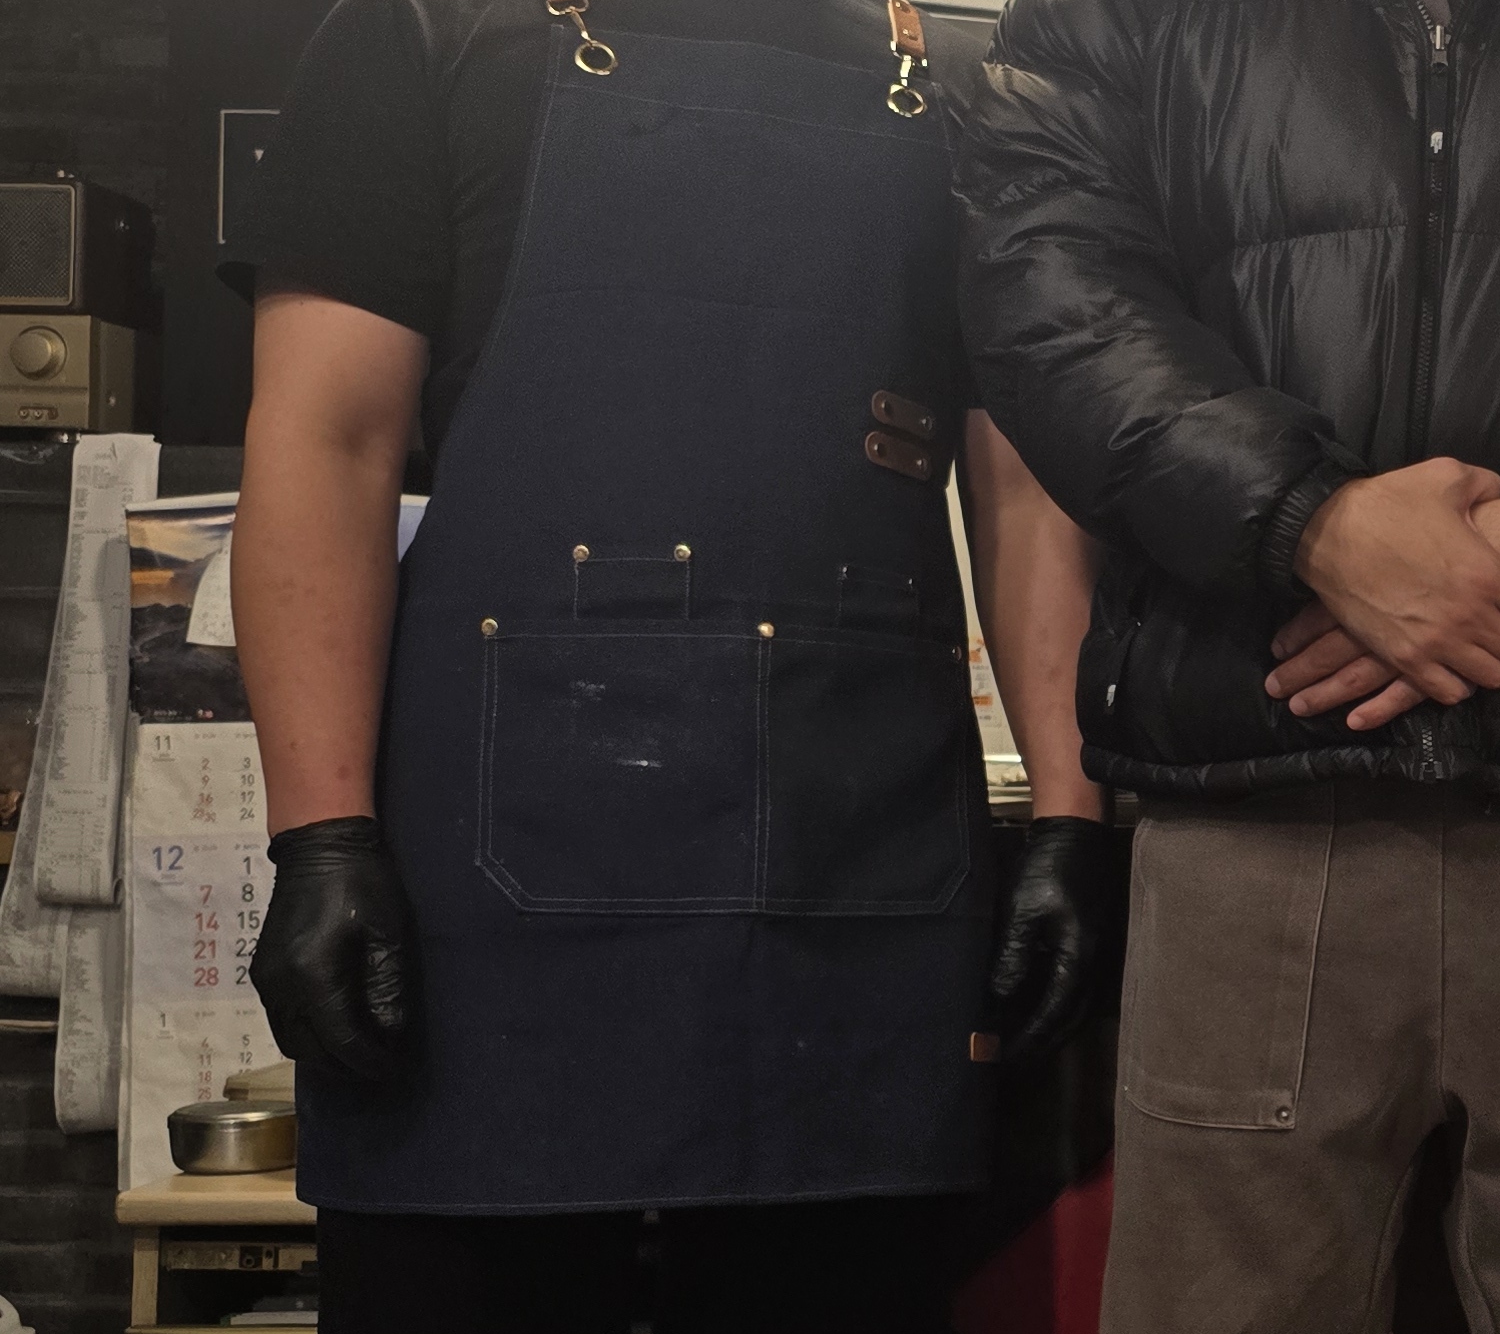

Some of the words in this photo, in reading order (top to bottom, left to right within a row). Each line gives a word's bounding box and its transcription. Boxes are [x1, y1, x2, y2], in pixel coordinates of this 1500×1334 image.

[154, 735, 171, 751] 11
[201, 757, 212, 771] 2
[243, 757, 251, 770] 3
[201, 775, 210, 790] 9
[240, 773, 255, 787] 10
[198, 792, 213, 805] 16
[240, 791, 255, 804] 17
[240, 807, 255, 821] 24
[152, 845, 184, 871] 12
[243, 856, 251, 875] 1
[200, 884, 213, 905] 7
[242, 883, 254, 903] 8
[195, 912, 220, 932] 14
[237, 910, 260, 930] 15
[194, 939, 216, 959] 21
[236, 938, 258, 957] 22
[194, 966, 220, 987] 28
[160, 1013, 167, 1028] 1
[201, 1036, 210, 1051] 4
[242, 1033, 251, 1046] 5
[198, 1053, 212, 1066] 11
[239, 1051, 253, 1065] 12
[198, 1070, 212, 1084] 18
[198, 1087, 212, 1100] 25
